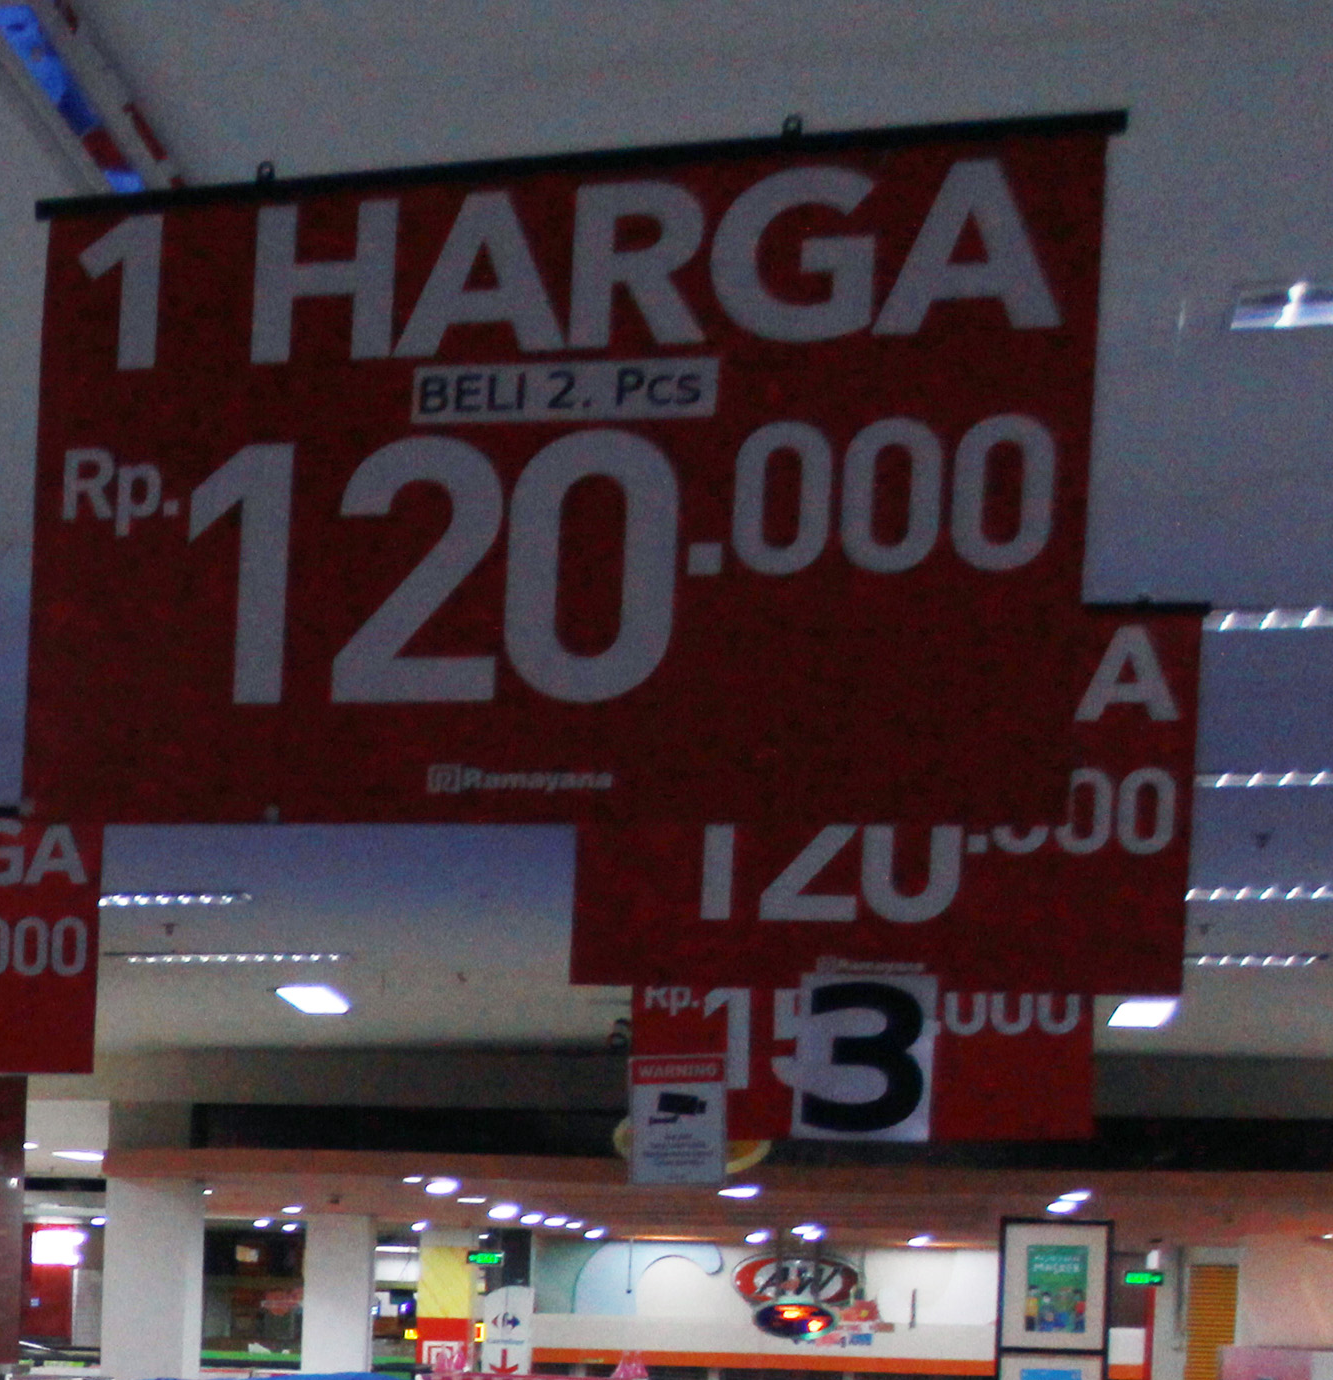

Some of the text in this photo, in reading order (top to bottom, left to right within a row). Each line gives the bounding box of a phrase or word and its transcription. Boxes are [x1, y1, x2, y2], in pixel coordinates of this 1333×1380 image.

[80, 160, 1061, 370] 1 HARGA
[419, 372, 527, 415] BELI
[462, 767, 613, 794] Ramayana
[638, 1062, 718, 1078] WARNING
[801, 981, 925, 1132] 3
